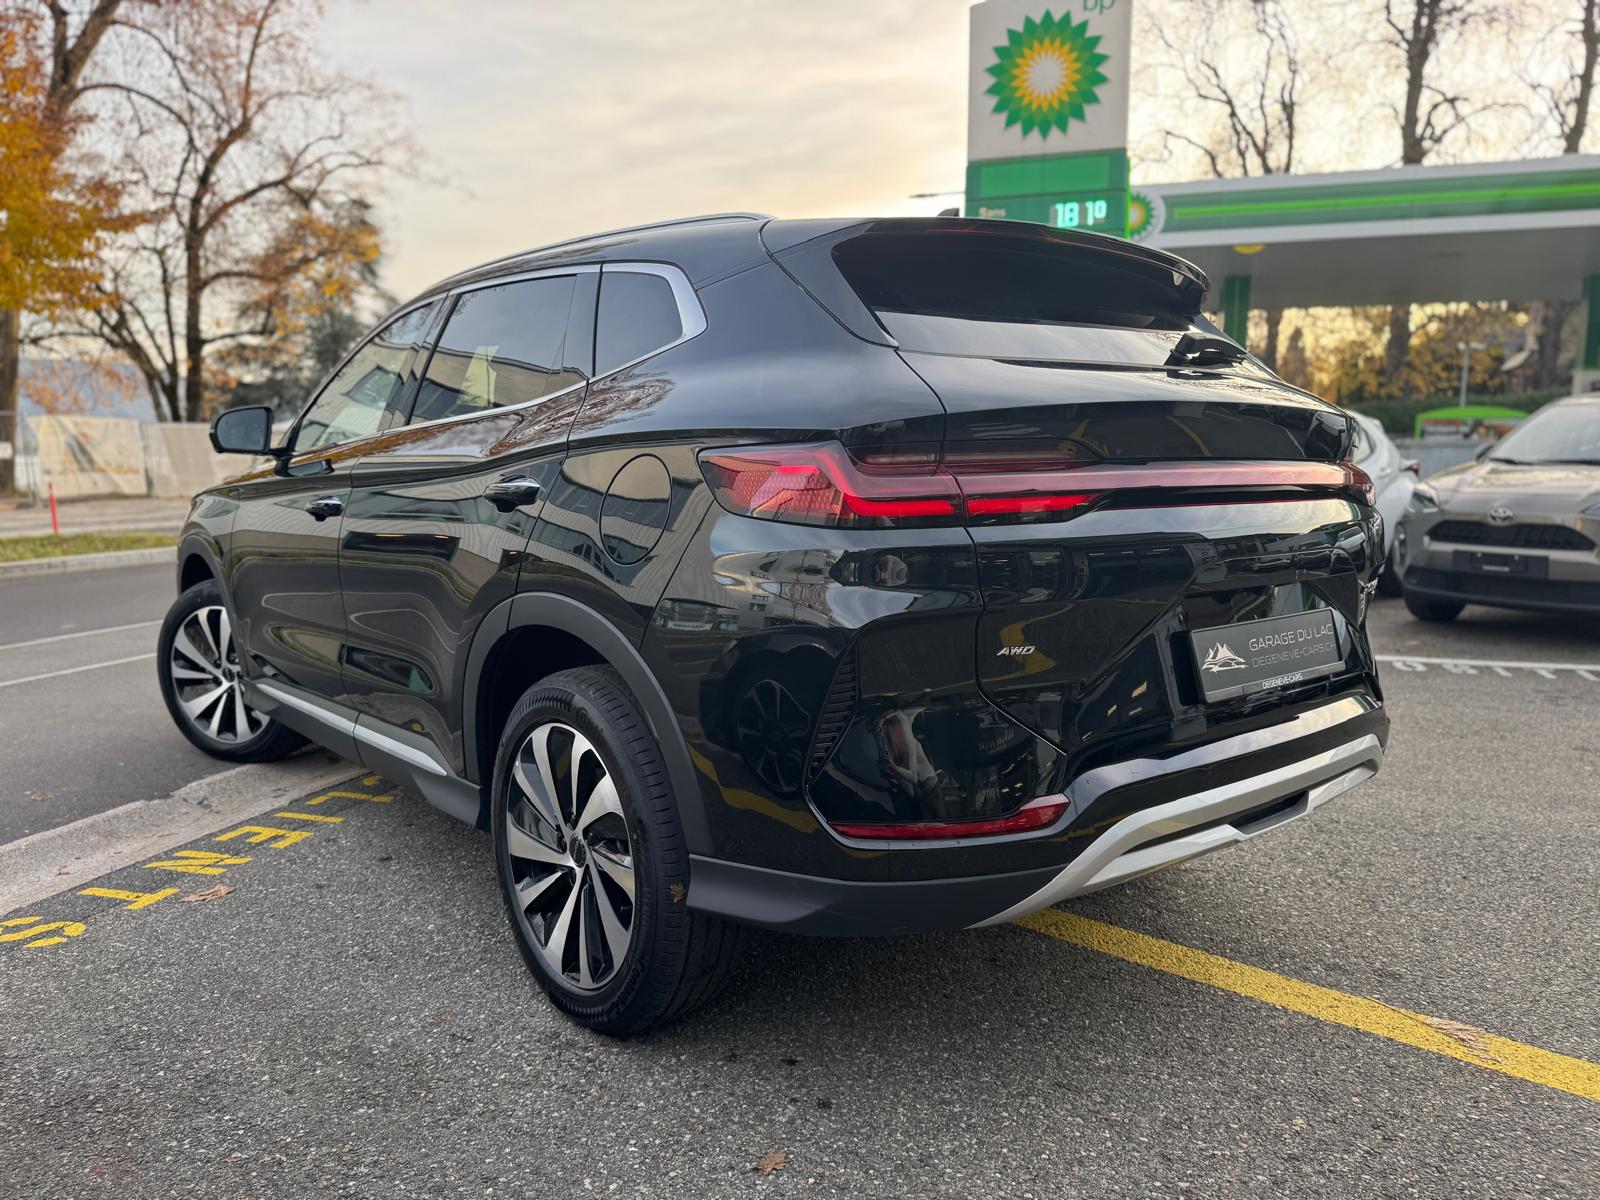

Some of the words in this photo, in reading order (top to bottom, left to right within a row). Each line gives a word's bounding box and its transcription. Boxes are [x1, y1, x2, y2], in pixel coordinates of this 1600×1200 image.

[996, 645, 1036, 656] AWD
[1249, 631, 1296, 651] GARAGE
[1297, 628, 1313, 642] DU
[1314, 624, 1334, 638] LAC
[0, 775, 395, 948] LIENTS
